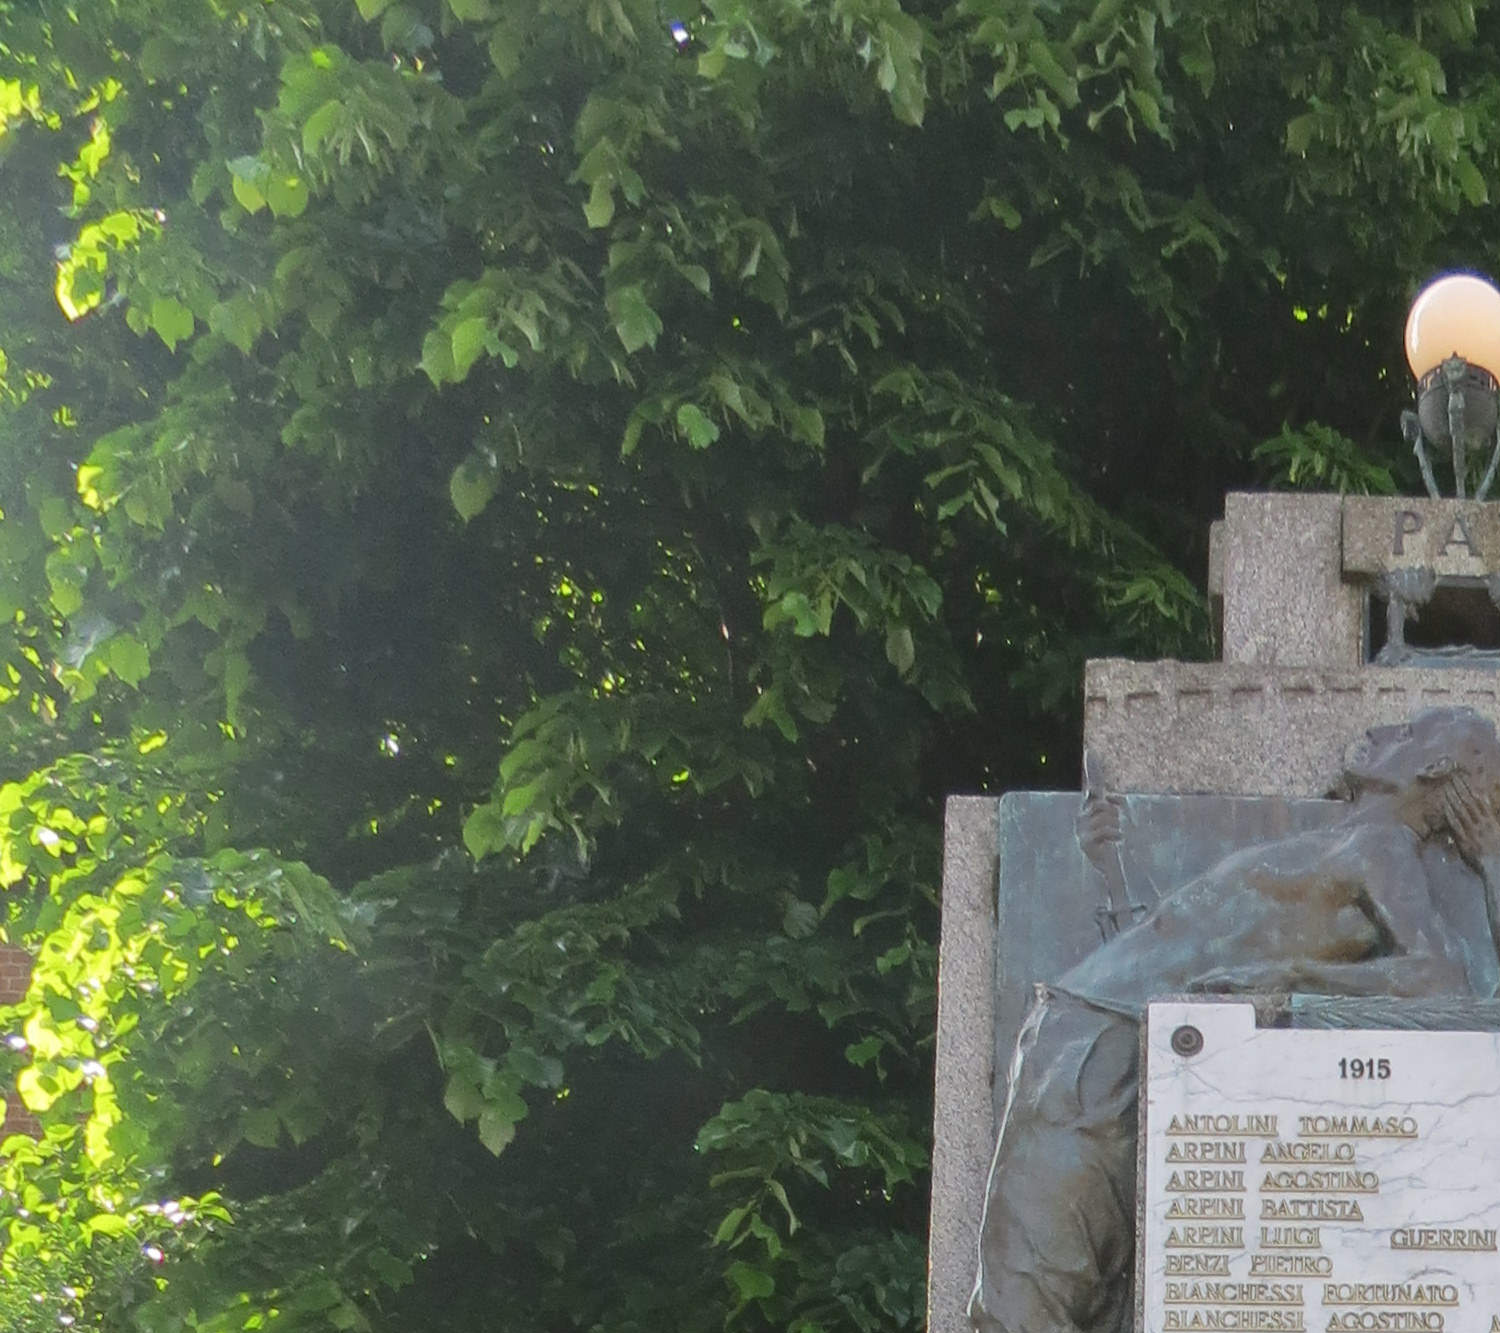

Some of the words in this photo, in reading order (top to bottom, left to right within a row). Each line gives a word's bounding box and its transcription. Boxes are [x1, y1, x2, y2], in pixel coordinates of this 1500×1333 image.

[1338, 1058, 1391, 1079] 1915
[1166, 1114, 1278, 1136] ANTOLINI
[1299, 1116, 1418, 1138] TOMMASO
[1165, 1198, 1245, 1219] ARPINI
[1260, 1200, 1363, 1221] BATTISTA
[1390, 1229, 1497, 1250] GUERRINI
[1164, 1283, 1304, 1305] BIANCHESSI
[1322, 1284, 1459, 1306] FORTUNATO
